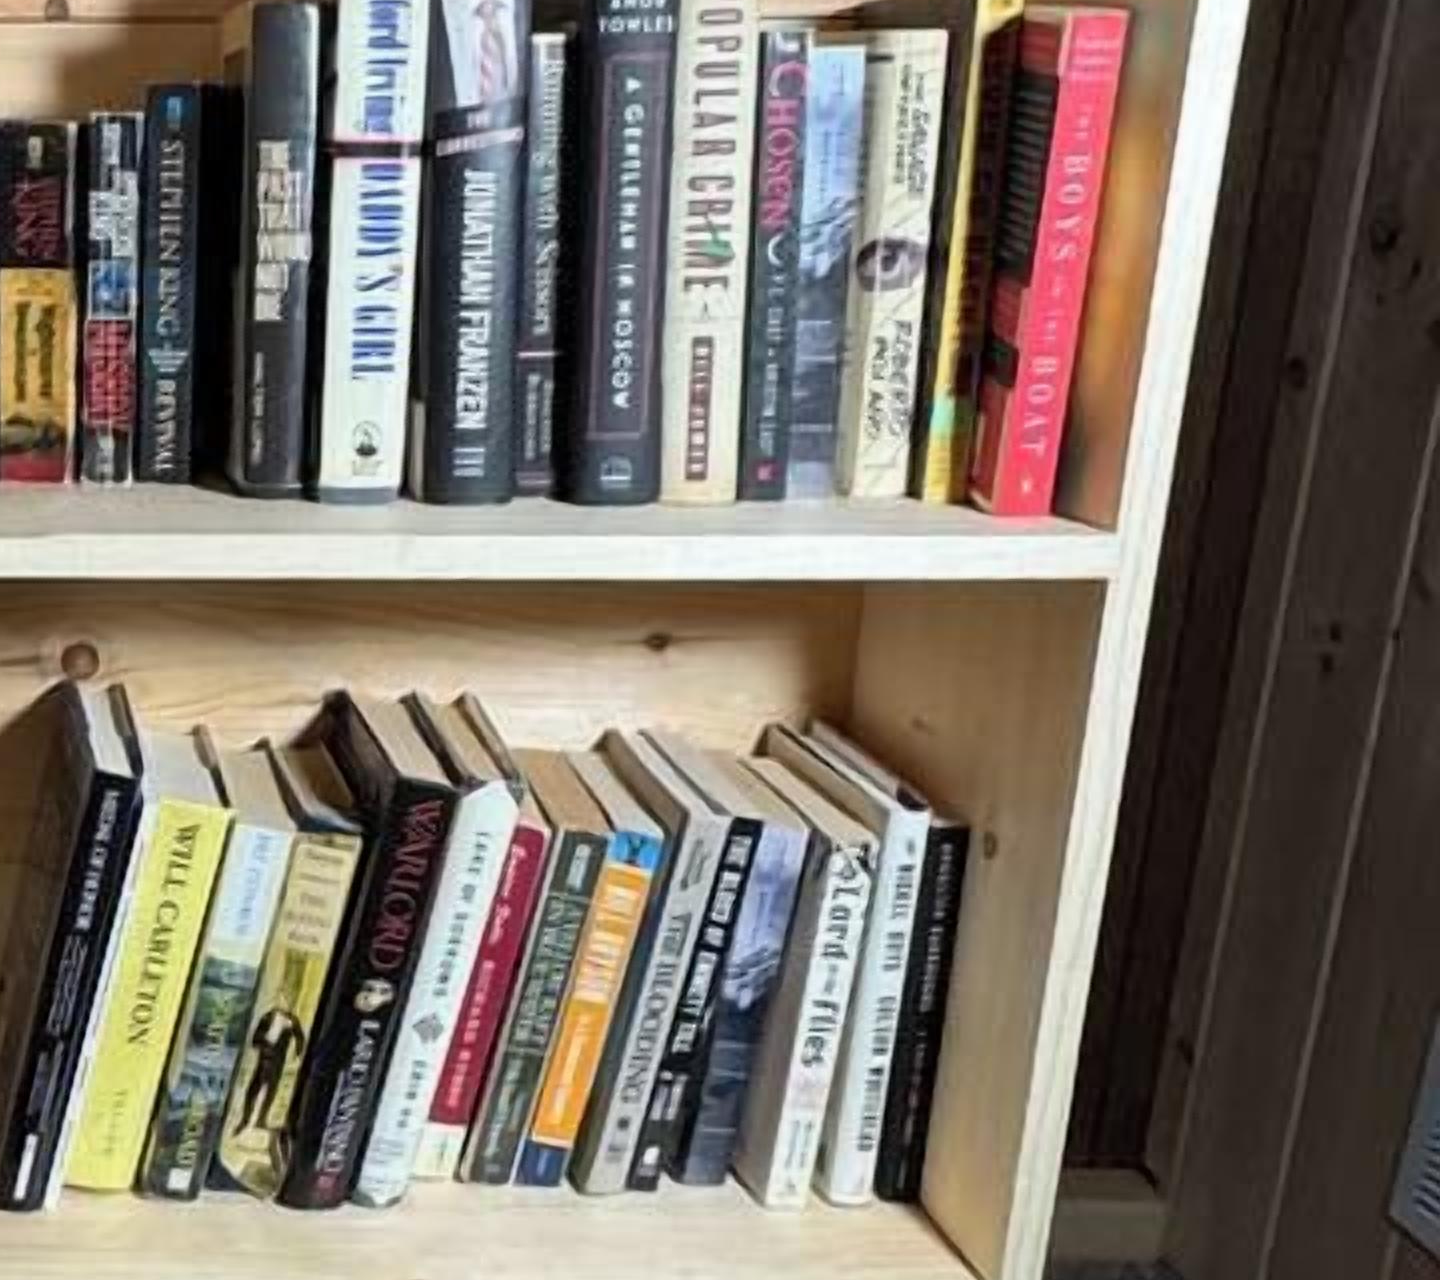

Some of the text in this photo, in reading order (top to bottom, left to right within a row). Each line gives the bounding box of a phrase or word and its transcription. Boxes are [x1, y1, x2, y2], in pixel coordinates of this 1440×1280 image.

[359, 59, 411, 134] Irving
[761, 59, 811, 232] CHOSEN
[158, 139, 186, 261] STEPHEN
[356, 164, 406, 293] DADDY'S
[618, 102, 642, 250] GENTLEMAN
[681, 174, 736, 296] CRIME
[1055, 153, 1094, 263] BOYS
[156, 266, 182, 338] KING
[351, 305, 399, 381] GIRL
[453, 171, 498, 429] JONATHAN FRANZEN
[610, 299, 634, 411] MOSCOW
[1019, 354, 1058, 458] BOAT
[367, 800, 446, 970] WARLORD
[466, 830, 492, 874] LAKE
[126, 824, 201, 1046] WILL CARLETON
[431, 911, 469, 999] SORROWS
[801, 883, 864, 1069] Lord Flies
[619, 962, 680, 1104] BLOODING
